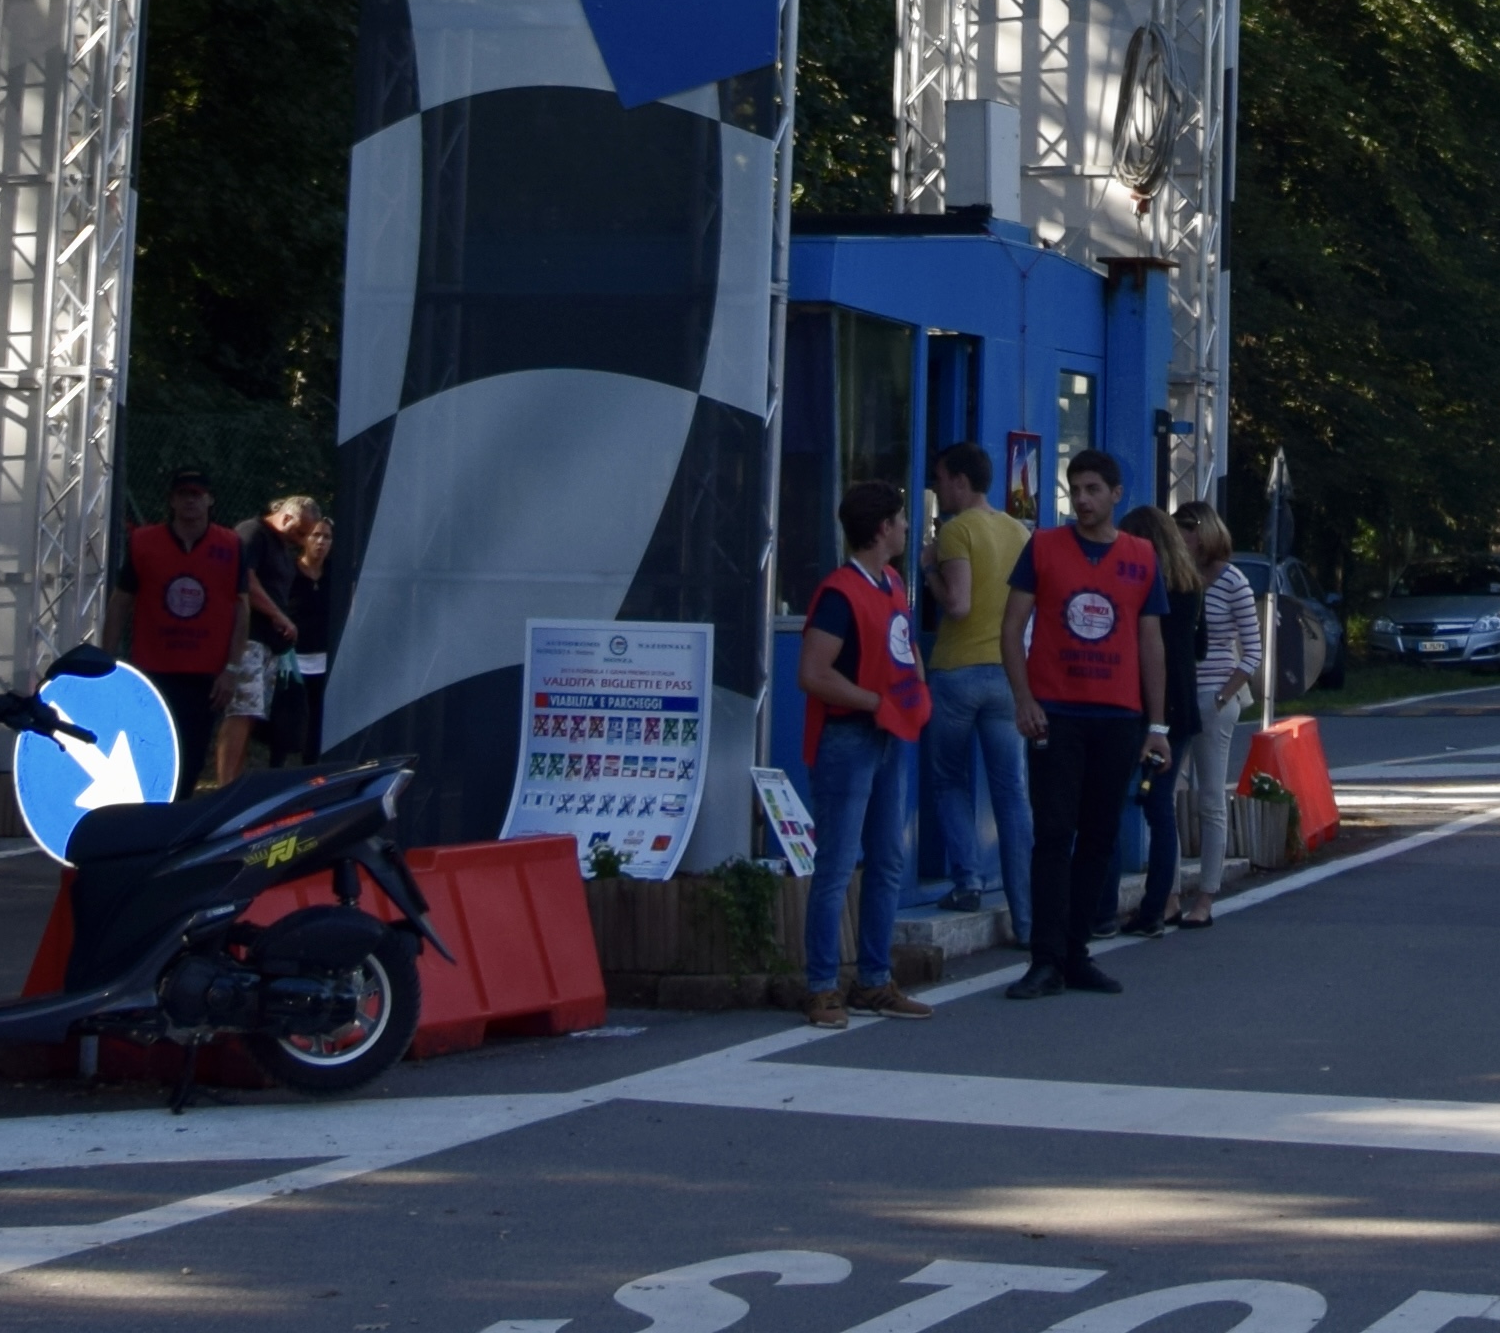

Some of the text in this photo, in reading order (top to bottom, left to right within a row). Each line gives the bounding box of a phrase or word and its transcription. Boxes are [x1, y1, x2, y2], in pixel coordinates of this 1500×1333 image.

[601, 678, 652, 689] BIGLIETTI
[656, 680, 661, 689] E
[665, 680, 692, 690] PASS
[600, 696, 605, 707] E
[608, 697, 662, 709] PARCHEGGI
